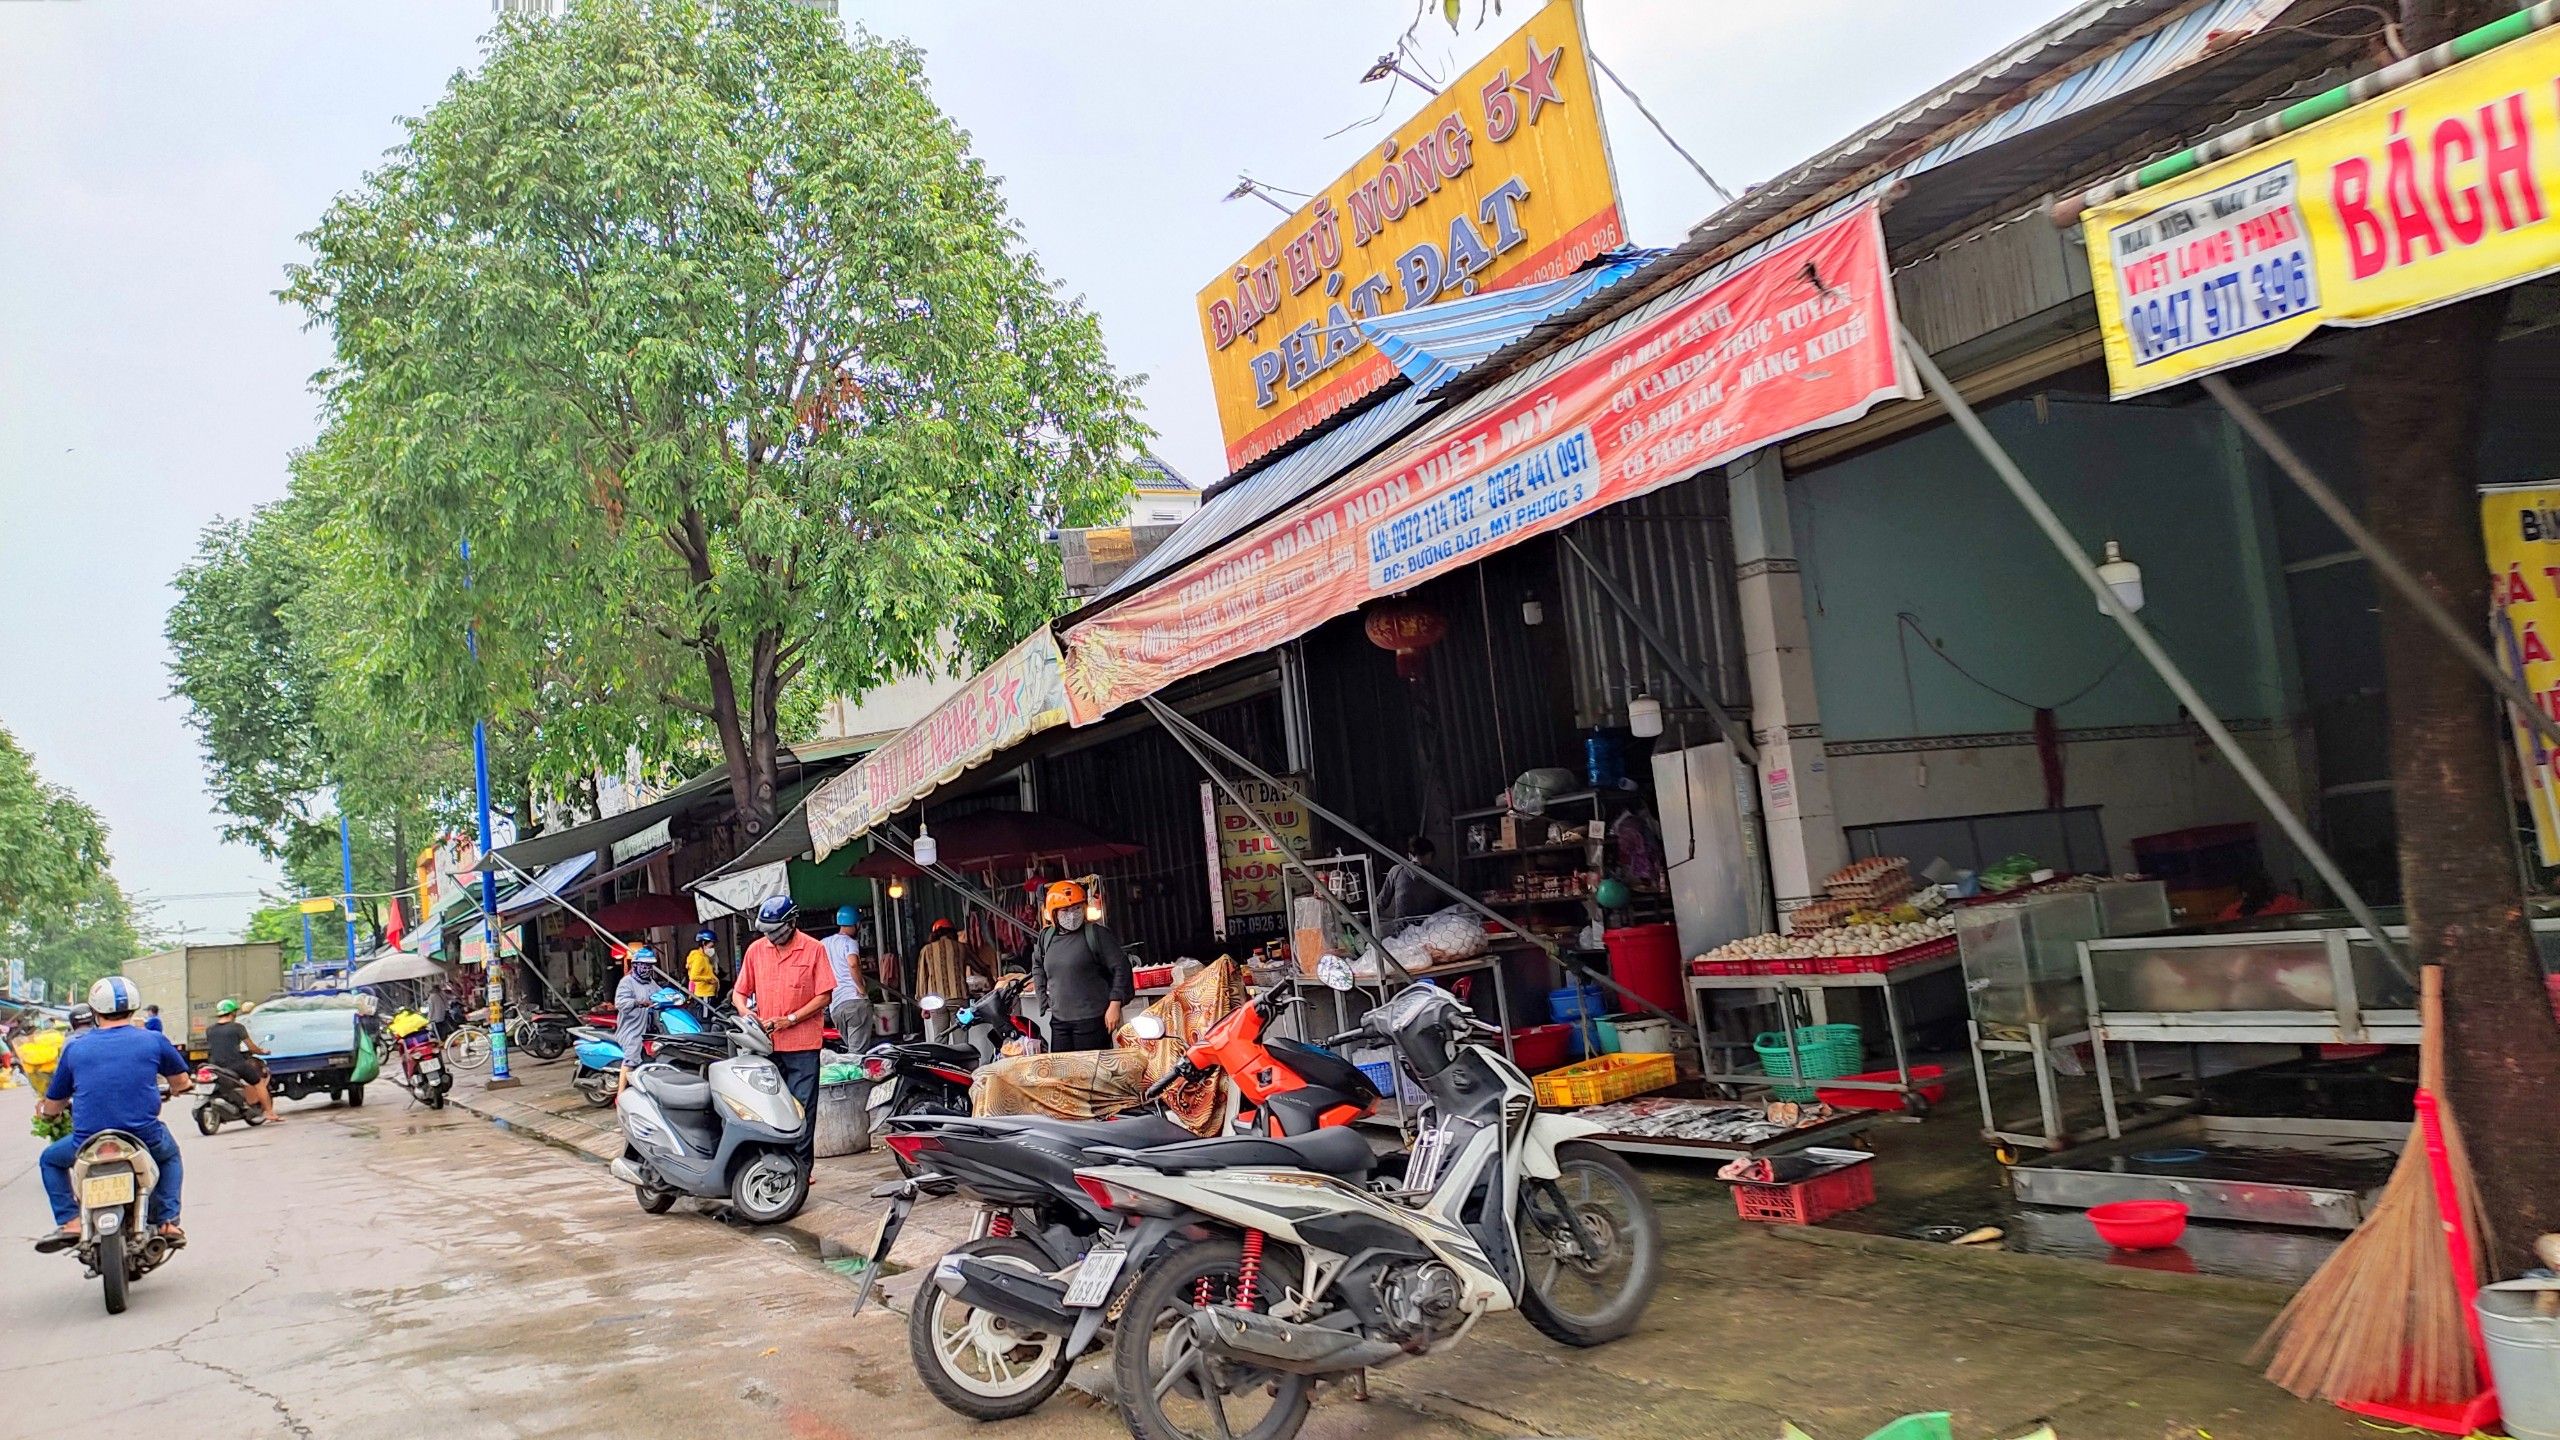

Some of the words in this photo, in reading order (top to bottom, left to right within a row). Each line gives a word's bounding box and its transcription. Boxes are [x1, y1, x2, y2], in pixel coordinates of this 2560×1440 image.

[1209, 260, 1280, 350] ĐẬU
[1346, 111, 1473, 247] NÓNG
[1480, 66, 1518, 142] 5
[2331, 93, 2549, 281] BÁCH
[1250, 272, 1392, 410] PHÁT
[1396, 176, 1531, 311] ĐẠT
[1565, 241, 1589, 272] 300
[1592, 223, 1617, 253] 926
[2176, 229, 2235, 280] LONG
[2131, 288, 2194, 358] 0947
[2203, 271, 2246, 337] 977
[2252, 250, 2309, 320] 396
[1178, 547, 1267, 608] TRƯỜNG
[1343, 473, 1412, 529] NON
[1415, 432, 1489, 492] VIỆT
[1499, 392, 1560, 450] MỸ
[1391, 511, 1424, 555] 0972
[1424, 500, 1450, 538] 114
[1450, 485, 1474, 526] 797
[1527, 447, 1556, 490] 441
[1556, 432, 1589, 478] 097
[1490, 509, 1515, 539] MỸ
[1573, 483, 1584, 502] 3
[983, 673, 1000, 738] 5
[1233, 889, 1249, 908] 5
